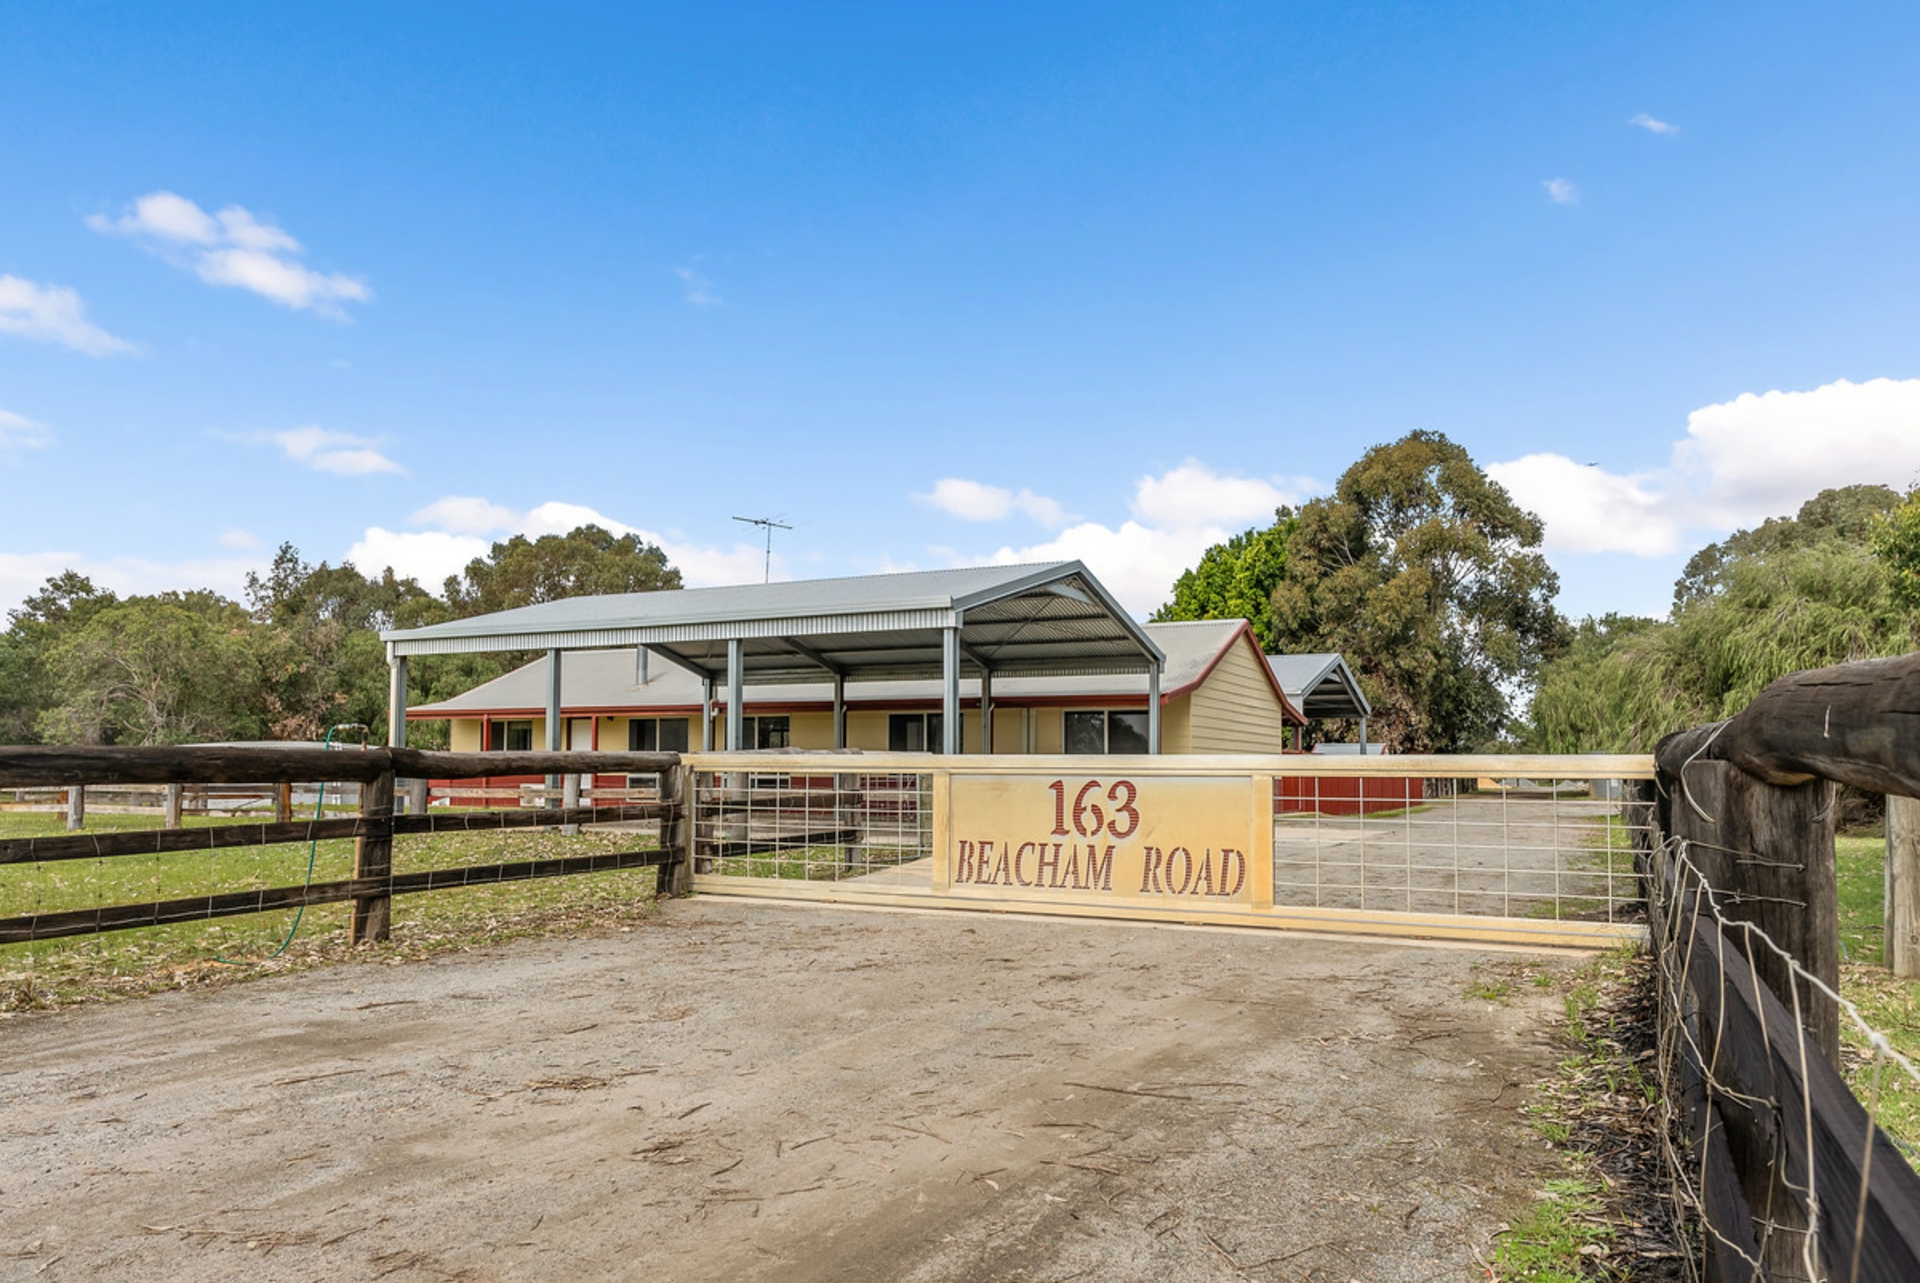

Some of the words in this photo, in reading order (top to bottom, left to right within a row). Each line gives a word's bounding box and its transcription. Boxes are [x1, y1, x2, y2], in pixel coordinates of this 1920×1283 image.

[1048, 779, 1140, 839] 163
[955, 840, 1116, 891] BEACHAM
[1139, 846, 1246, 896] ROAD
